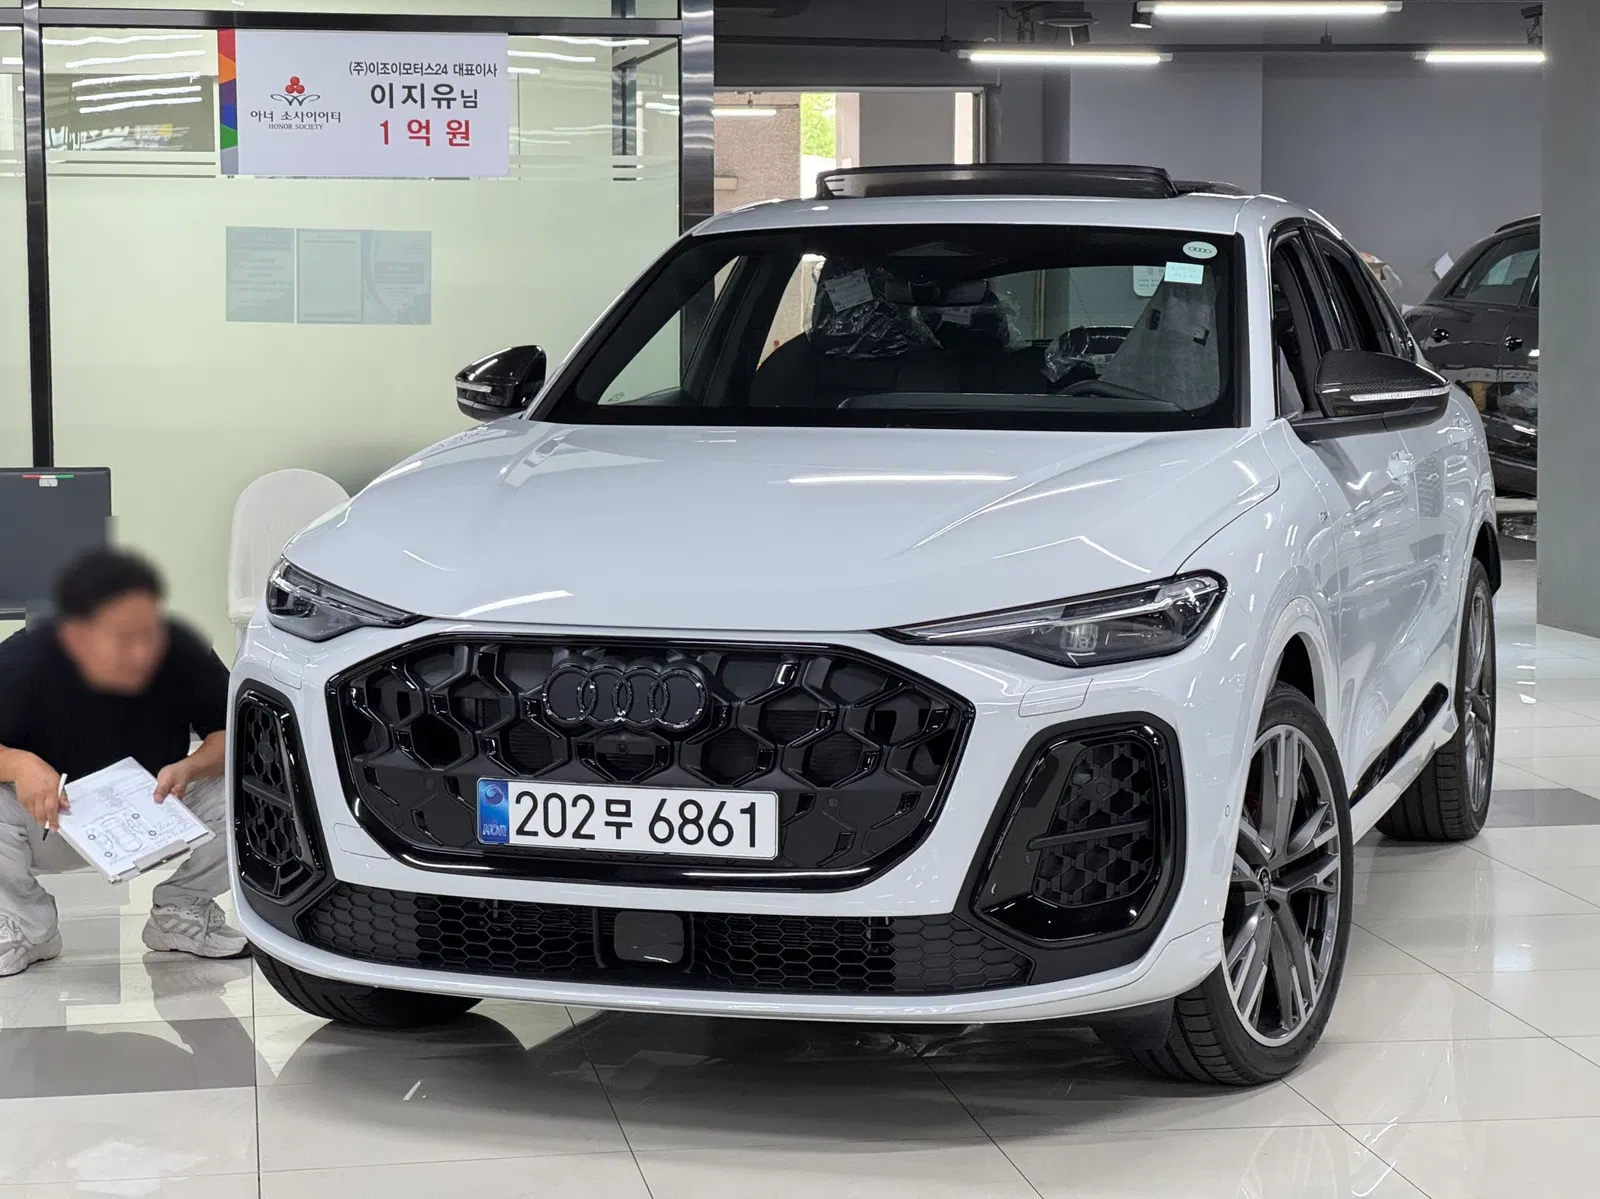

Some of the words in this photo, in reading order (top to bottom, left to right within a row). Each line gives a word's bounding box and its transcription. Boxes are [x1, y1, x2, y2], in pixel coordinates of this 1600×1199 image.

[349, 61, 448, 76] (주)이조이모터스24
[453, 62, 497, 77] 대표이사
[250, 110, 274, 122] 아너
[280, 110, 341, 123] 소사이어티
[482, 823, 507, 837] KOR
[649, 798, 756, 848] 6861
